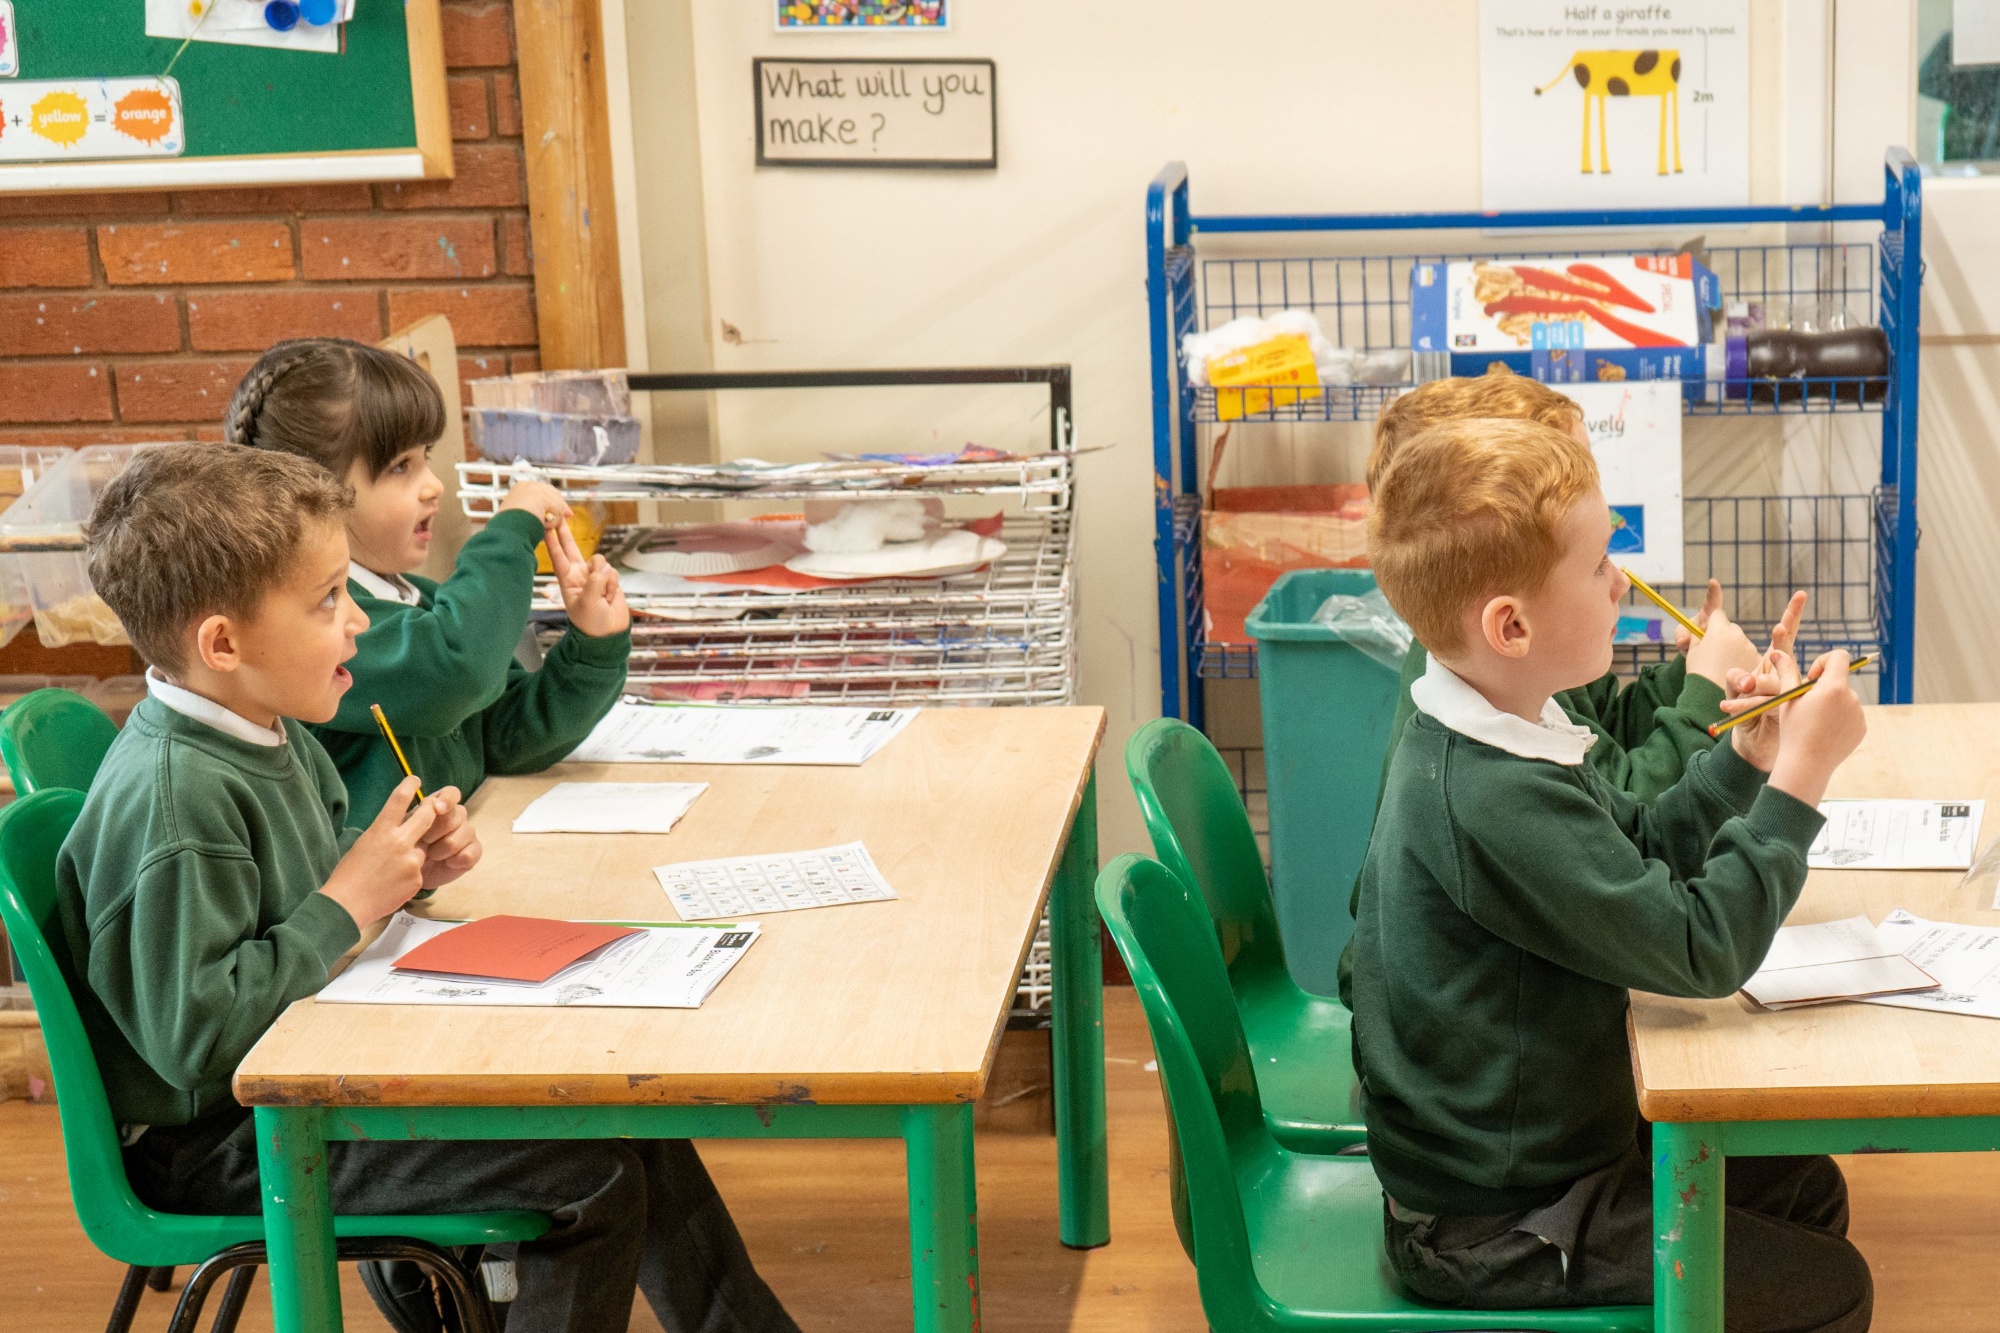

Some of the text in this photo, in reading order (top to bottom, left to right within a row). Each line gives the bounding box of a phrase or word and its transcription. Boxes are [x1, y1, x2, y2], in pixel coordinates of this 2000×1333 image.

[1564, 5, 1672, 24] Half a giraffe
[1527, 27, 1546, 37] how
[1565, 26, 1589, 37] from
[1592, 28, 1612, 38] your
[1615, 26, 1650, 36] friends
[1652, 28, 1669, 37] you
[1671, 26, 1694, 36] need
[764, 67, 985, 115] What will you
[1693, 90, 1714, 103] 2m
[38, 109, 83, 128] yellow
[121, 108, 167, 124] orange
[769, 113, 857, 145] make
[1584, 415, 1625, 437] vely
